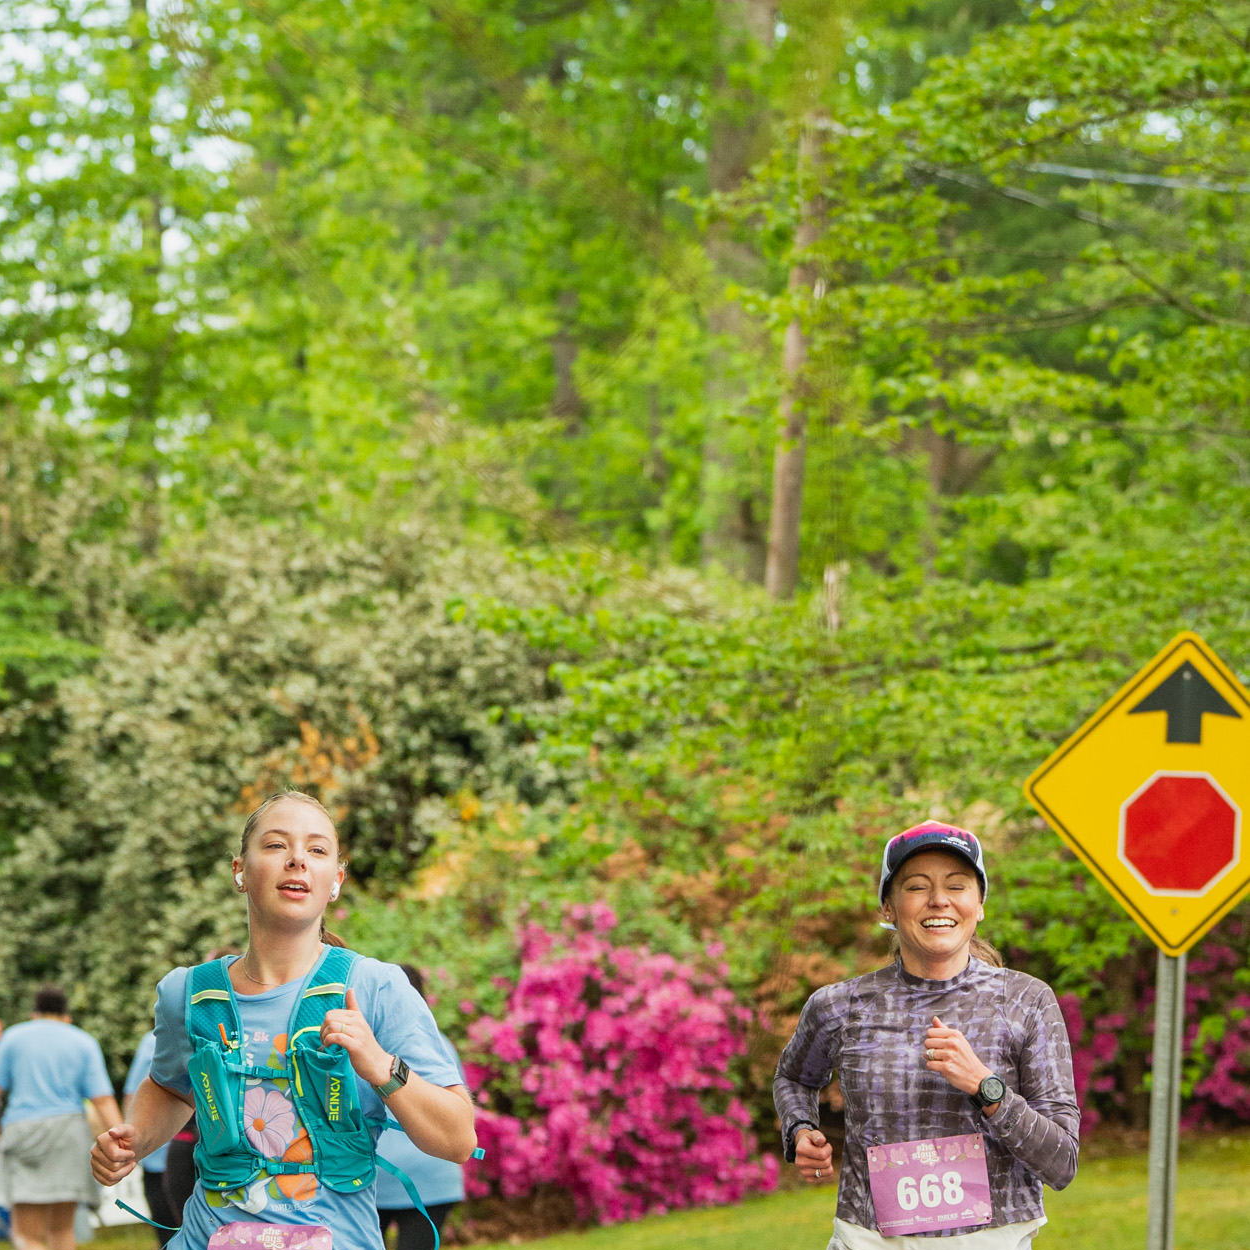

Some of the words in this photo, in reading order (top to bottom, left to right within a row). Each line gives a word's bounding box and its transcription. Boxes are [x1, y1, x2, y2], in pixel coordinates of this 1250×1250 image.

[253, 1031, 269, 1041] 5k
[897, 1171, 964, 1211] 668
[263, 1227, 281, 1235] she
